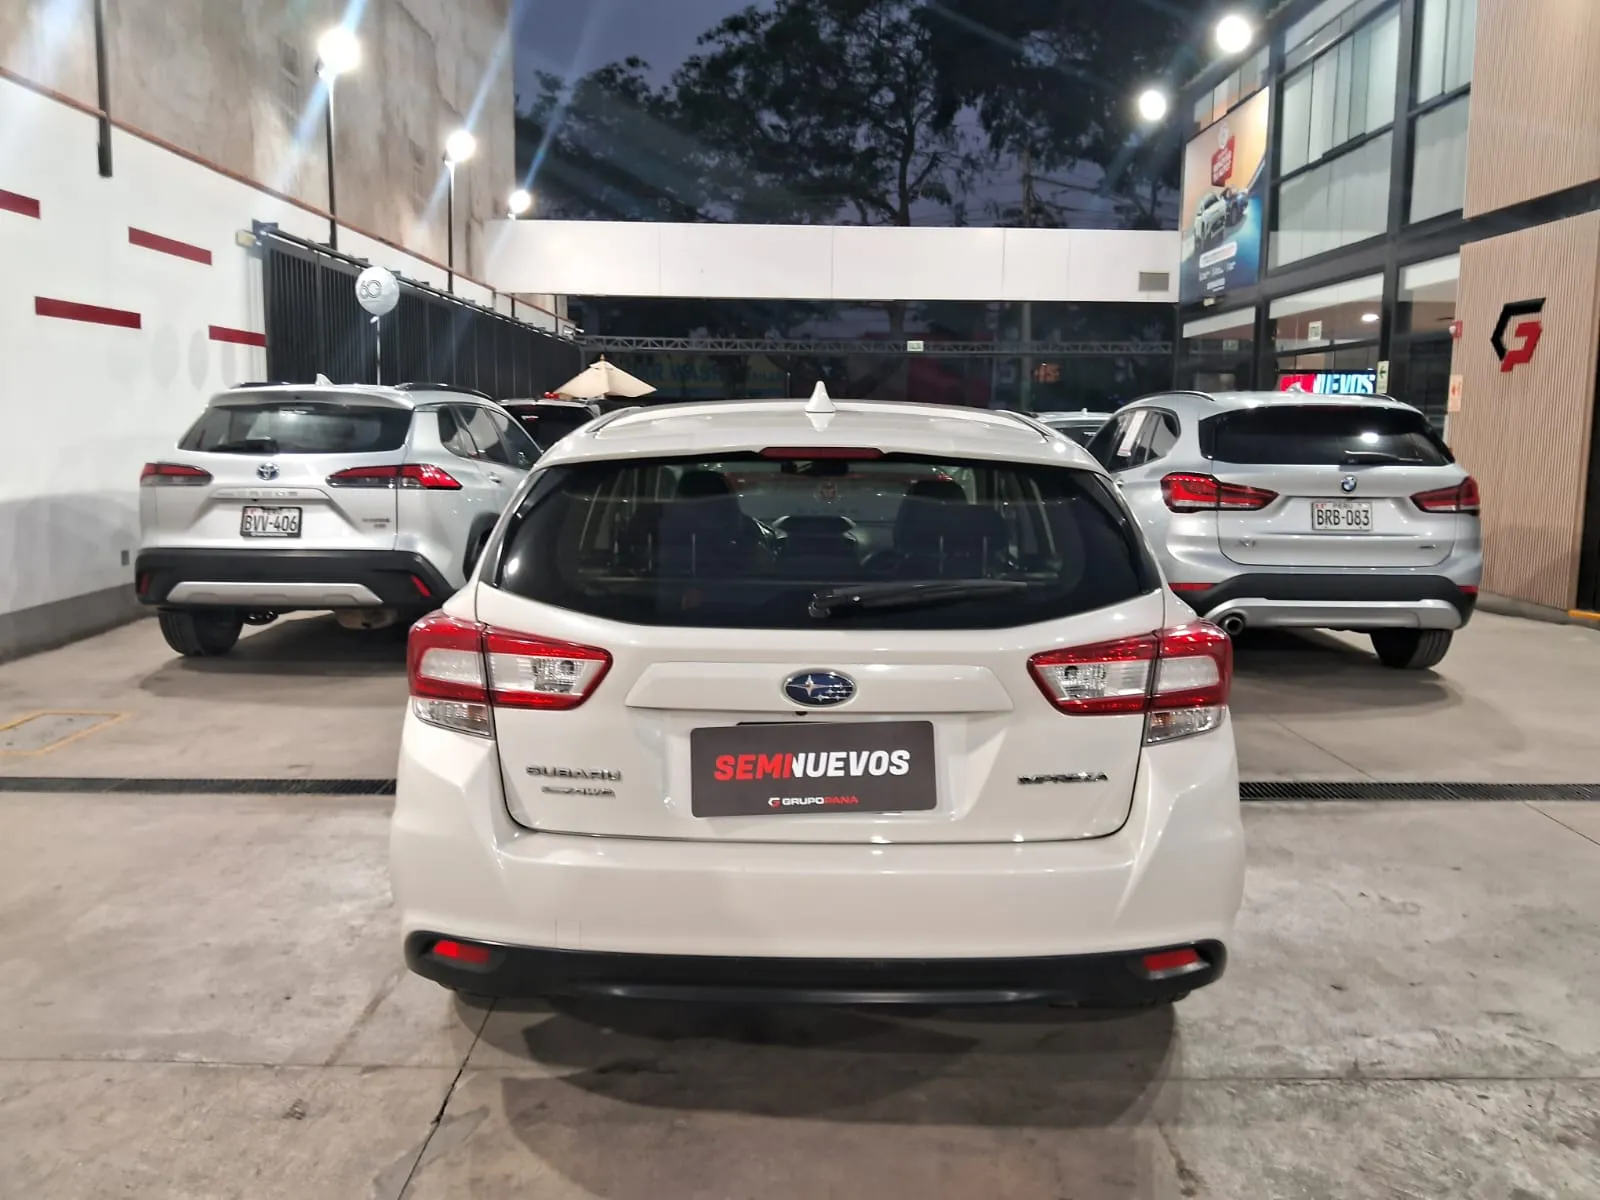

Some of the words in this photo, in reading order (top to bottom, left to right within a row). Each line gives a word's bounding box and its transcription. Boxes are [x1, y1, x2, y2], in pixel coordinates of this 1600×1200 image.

[244, 515, 297, 531] BVV-406
[1316, 509, 1370, 526] BRB-083
[714, 750, 911, 781] SEMINUEVOS
